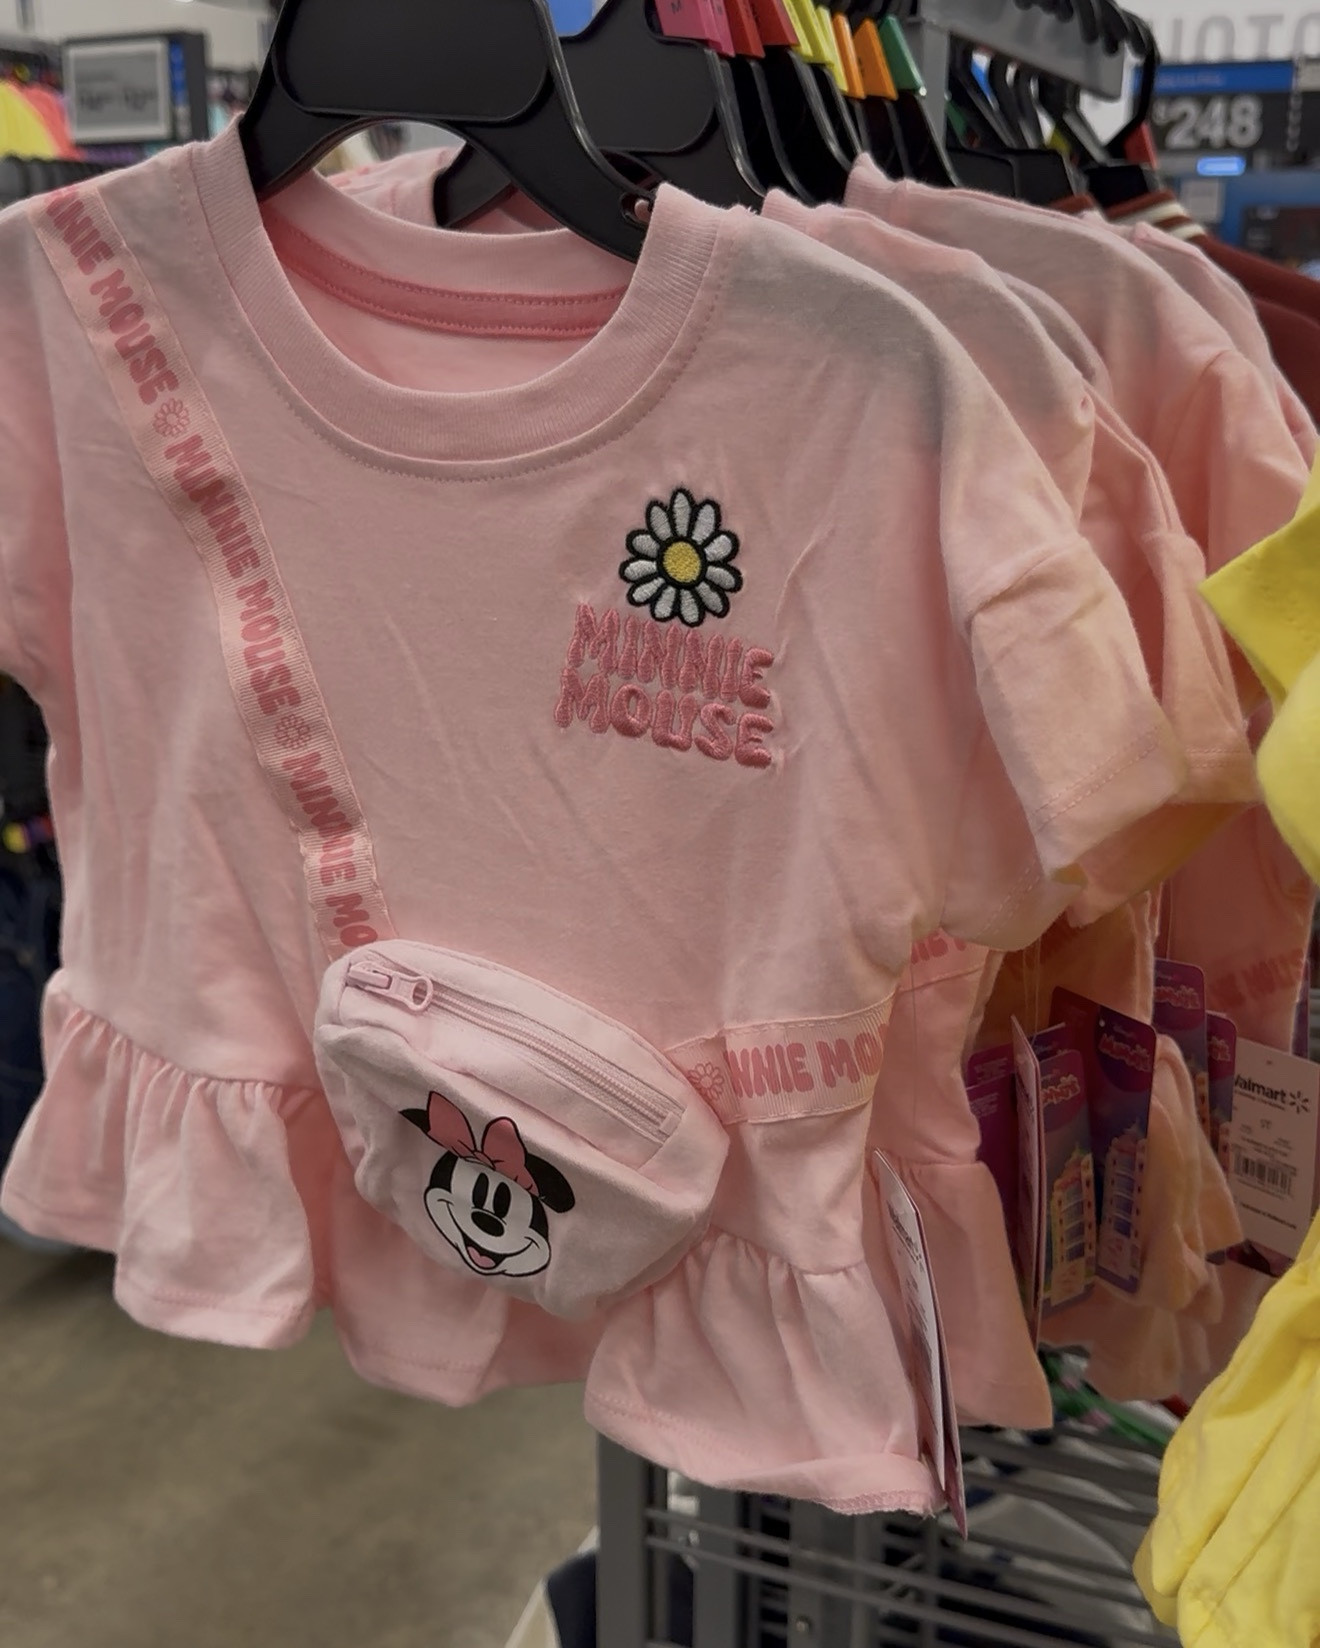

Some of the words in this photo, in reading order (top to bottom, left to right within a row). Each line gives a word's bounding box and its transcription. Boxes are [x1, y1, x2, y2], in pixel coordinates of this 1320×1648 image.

[90, 268, 178, 405] MOUSE
[164, 434, 260, 578] MINNIE
[236, 578, 302, 716] MOUSE
[567, 602, 774, 709] MINNIE
[554, 666, 774, 769] MOUSE
[281, 752, 357, 887] MINNIE
[325, 892, 378, 947] MO
[816, 1024, 888, 1088] MO
